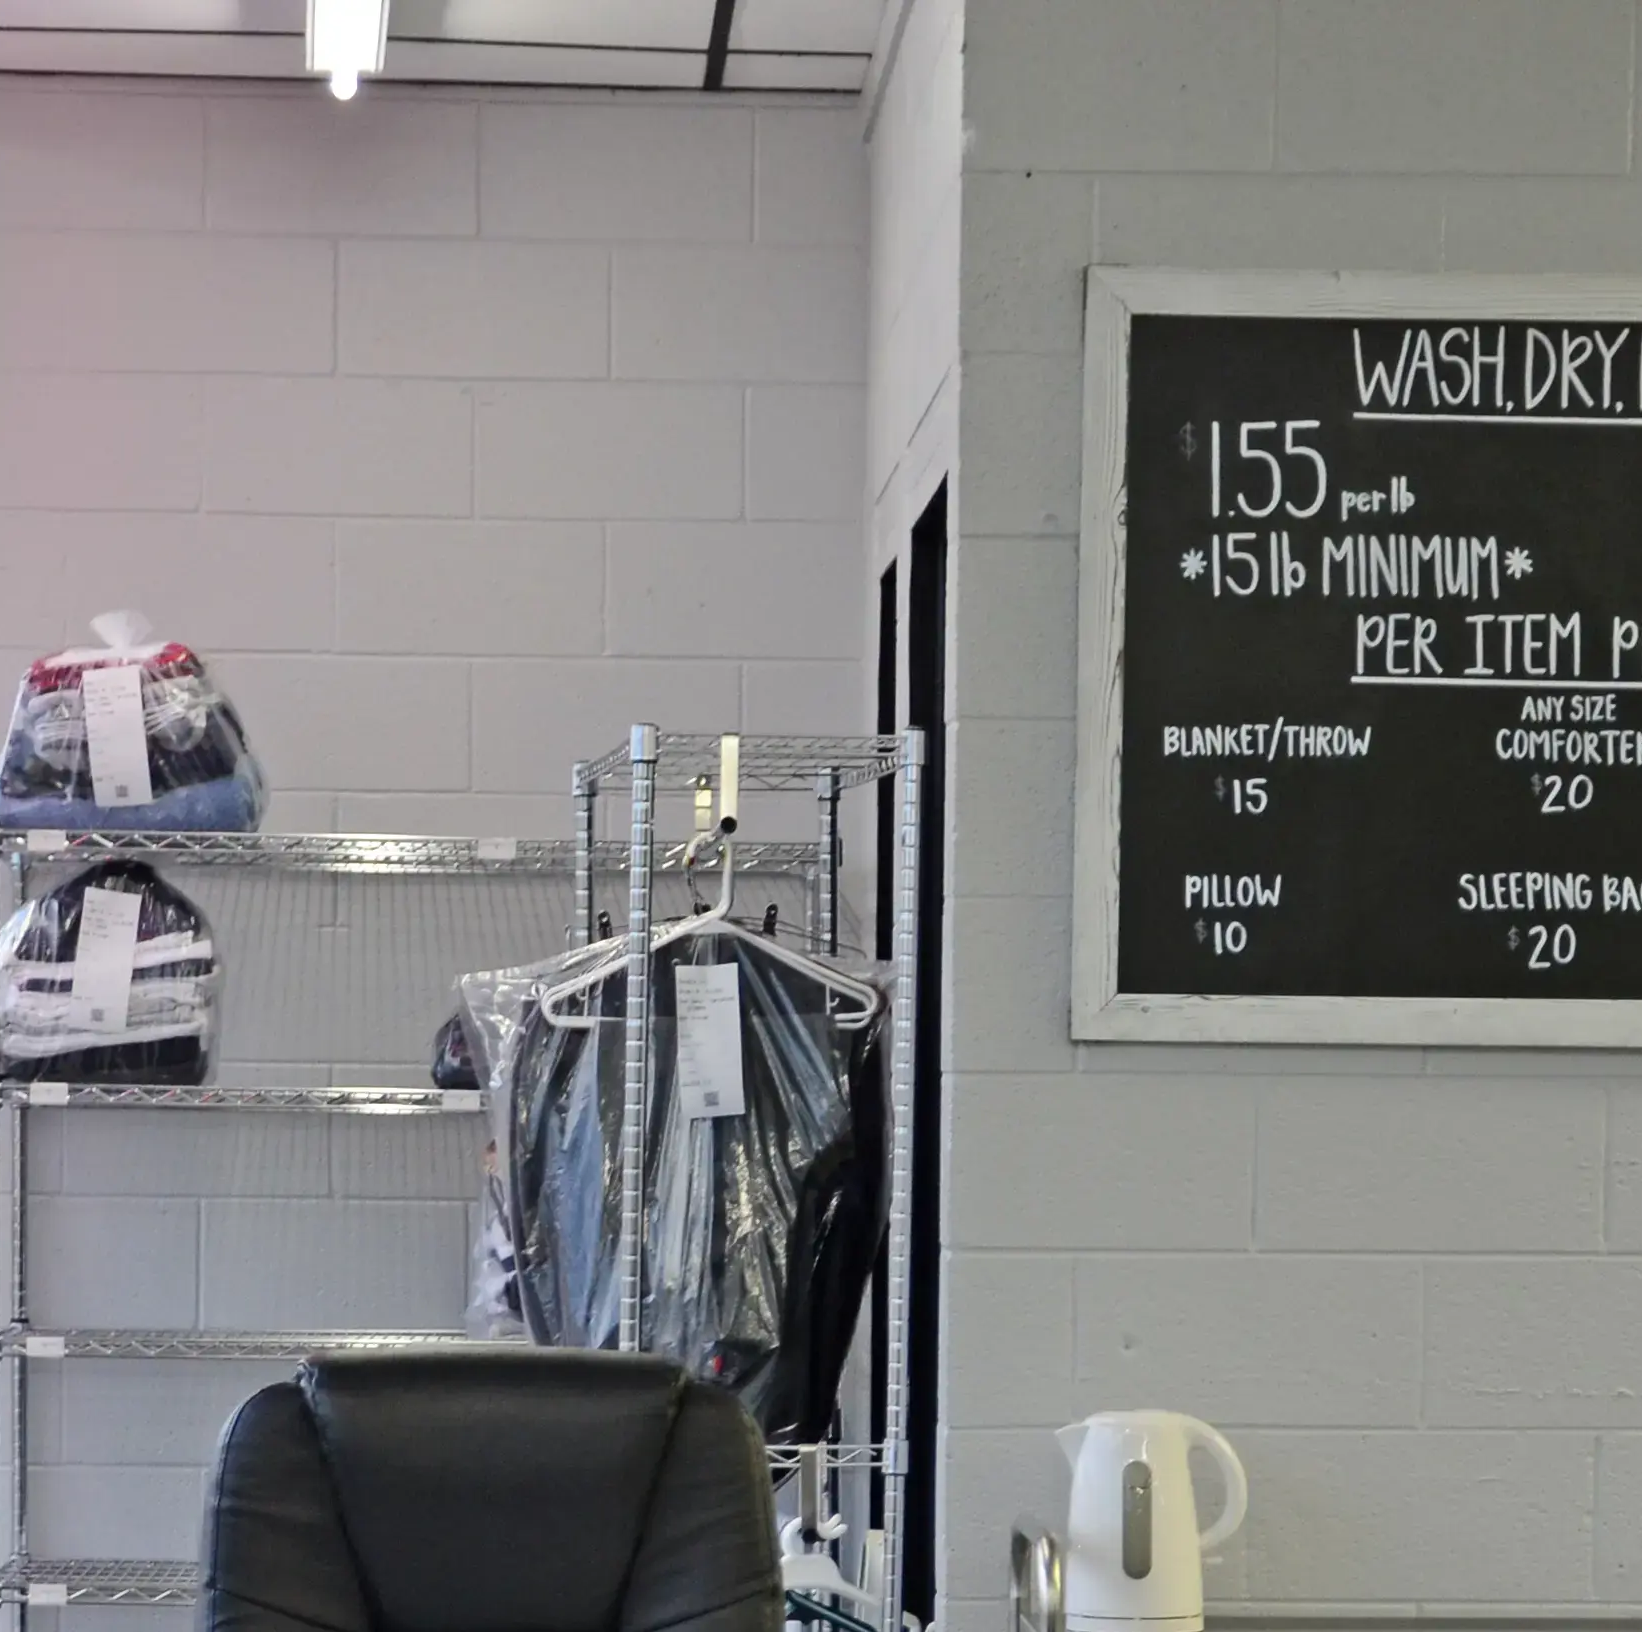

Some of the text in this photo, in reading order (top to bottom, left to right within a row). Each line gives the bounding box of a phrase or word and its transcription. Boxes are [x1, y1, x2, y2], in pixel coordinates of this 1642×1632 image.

[1352, 325, 1515, 412] WASH,
[1524, 327, 1631, 413] DRY,
[1340, 489, 1387, 523] per
[1391, 475, 1416, 514] lb
[1270, 530, 1307, 598] lb
[1355, 612, 1444, 676] PER
[1463, 611, 1582, 677] ITEM
[1520, 693, 1617, 722] ANY SIZE
[1162, 715, 1372, 763] BLANKET/THROW
[1184, 873, 1282, 910] PILLOW
[1457, 870, 1594, 912] SLEEPING
